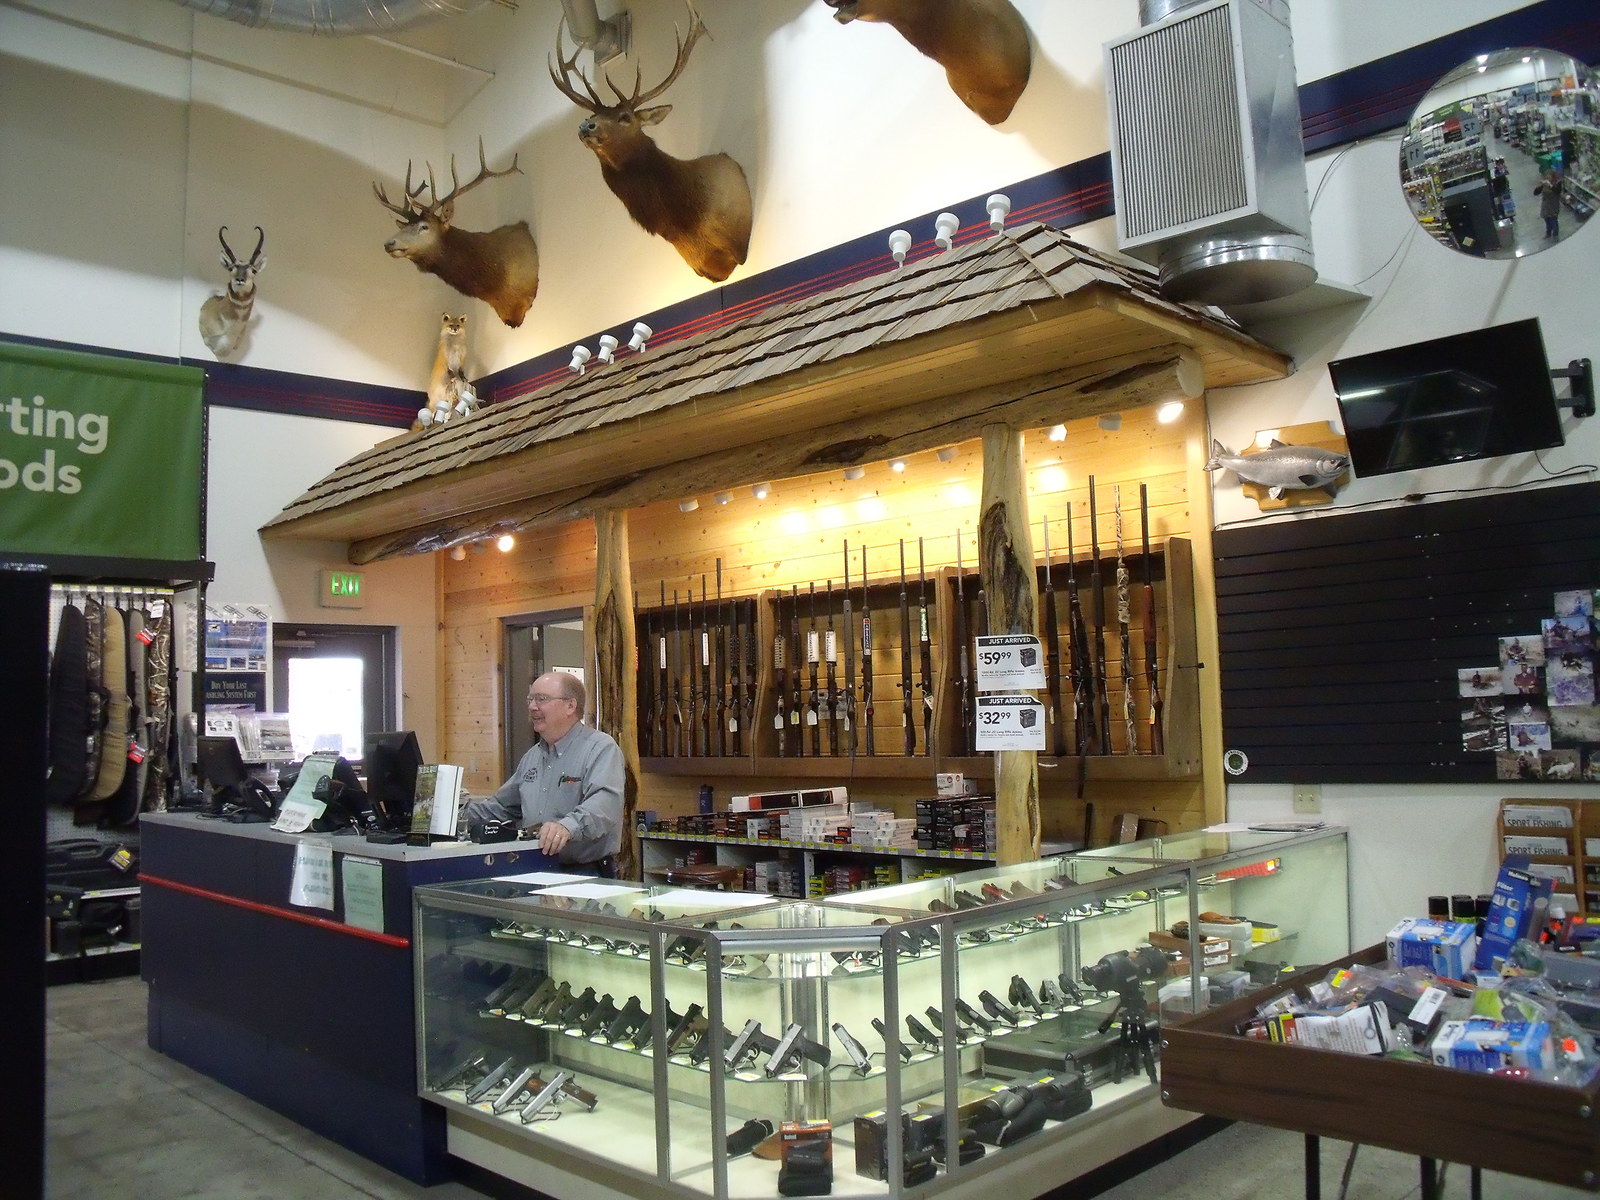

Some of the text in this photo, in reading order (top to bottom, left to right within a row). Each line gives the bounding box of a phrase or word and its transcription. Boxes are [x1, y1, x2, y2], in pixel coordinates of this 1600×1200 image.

[0, 395, 109, 454] ting
[331, 572, 361, 596] EXIT
[1507, 819, 1563, 828] SPORT FISHING
[1508, 846, 1564, 855] SPORT FISHING
